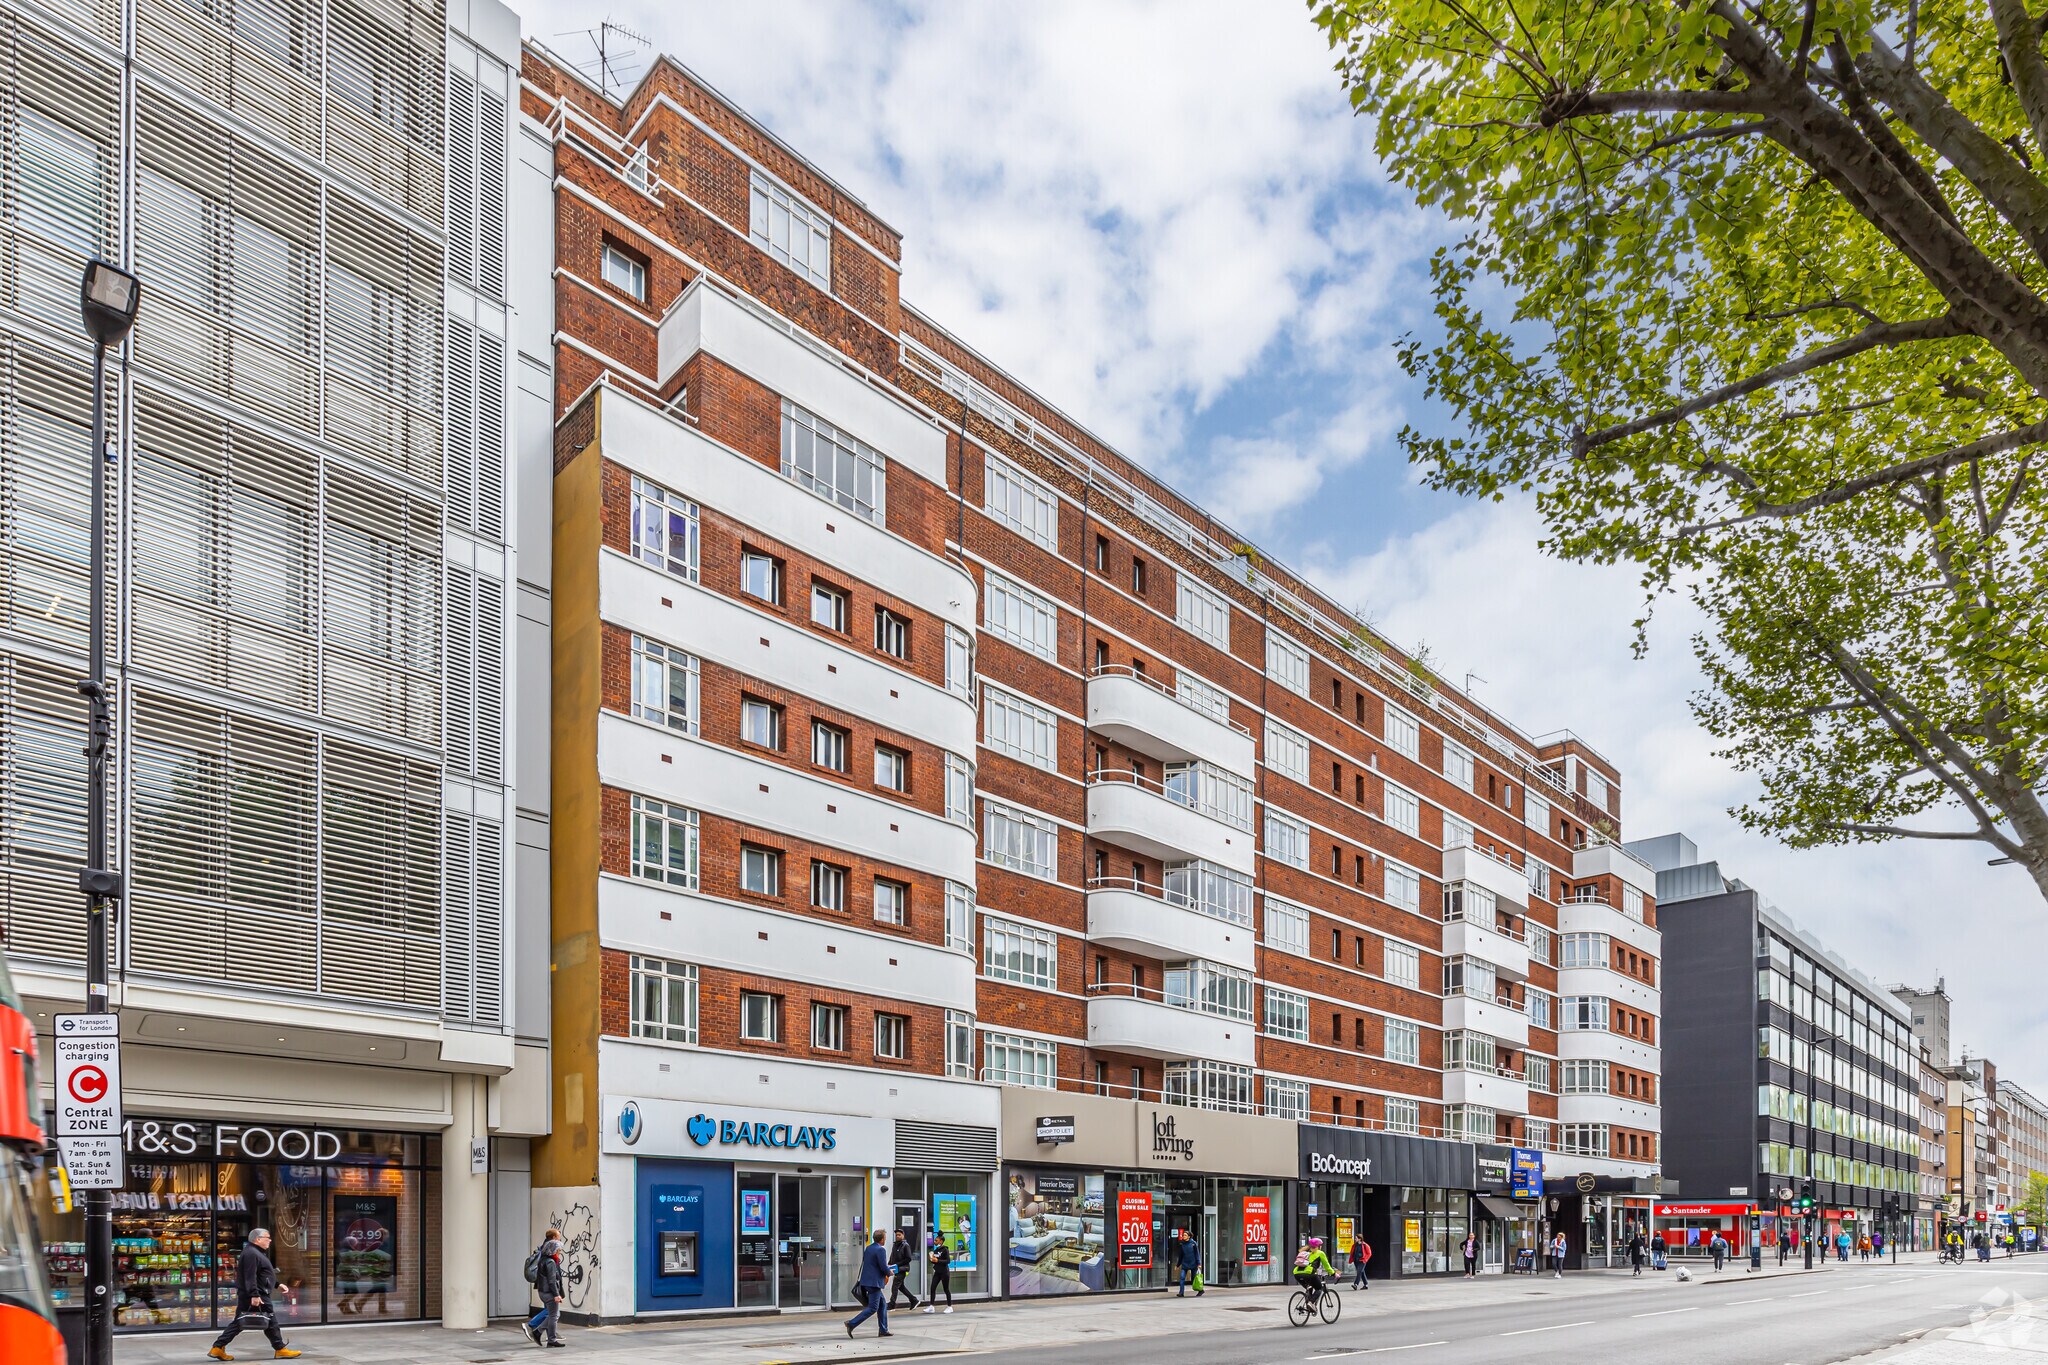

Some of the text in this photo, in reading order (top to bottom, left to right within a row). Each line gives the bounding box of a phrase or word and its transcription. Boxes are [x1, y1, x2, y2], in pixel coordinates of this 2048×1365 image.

[59, 1042, 116, 1051] Congestion
[65, 1052, 109, 1061] charging
[65, 1107, 113, 1117] Central
[69, 1120, 108, 1130] ZONE
[1152, 1111, 1177, 1138] loft
[719, 1119, 837, 1150] BARCLAYS
[215, 1125, 342, 1161] FOOD
[473, 1147, 486, 1158] M&S
[1311, 1152, 1371, 1180] BoConcept
[1040, 1180, 1075, 1190] Interior Design
[667, 1195, 698, 1203] BARCLAYS
[355, 1203, 376, 1211] M&S
[1673, 1206, 1711, 1214] Santander
[1122, 1222, 1149, 1242] 50%
[1246, 1223, 1267, 1242] 50%
